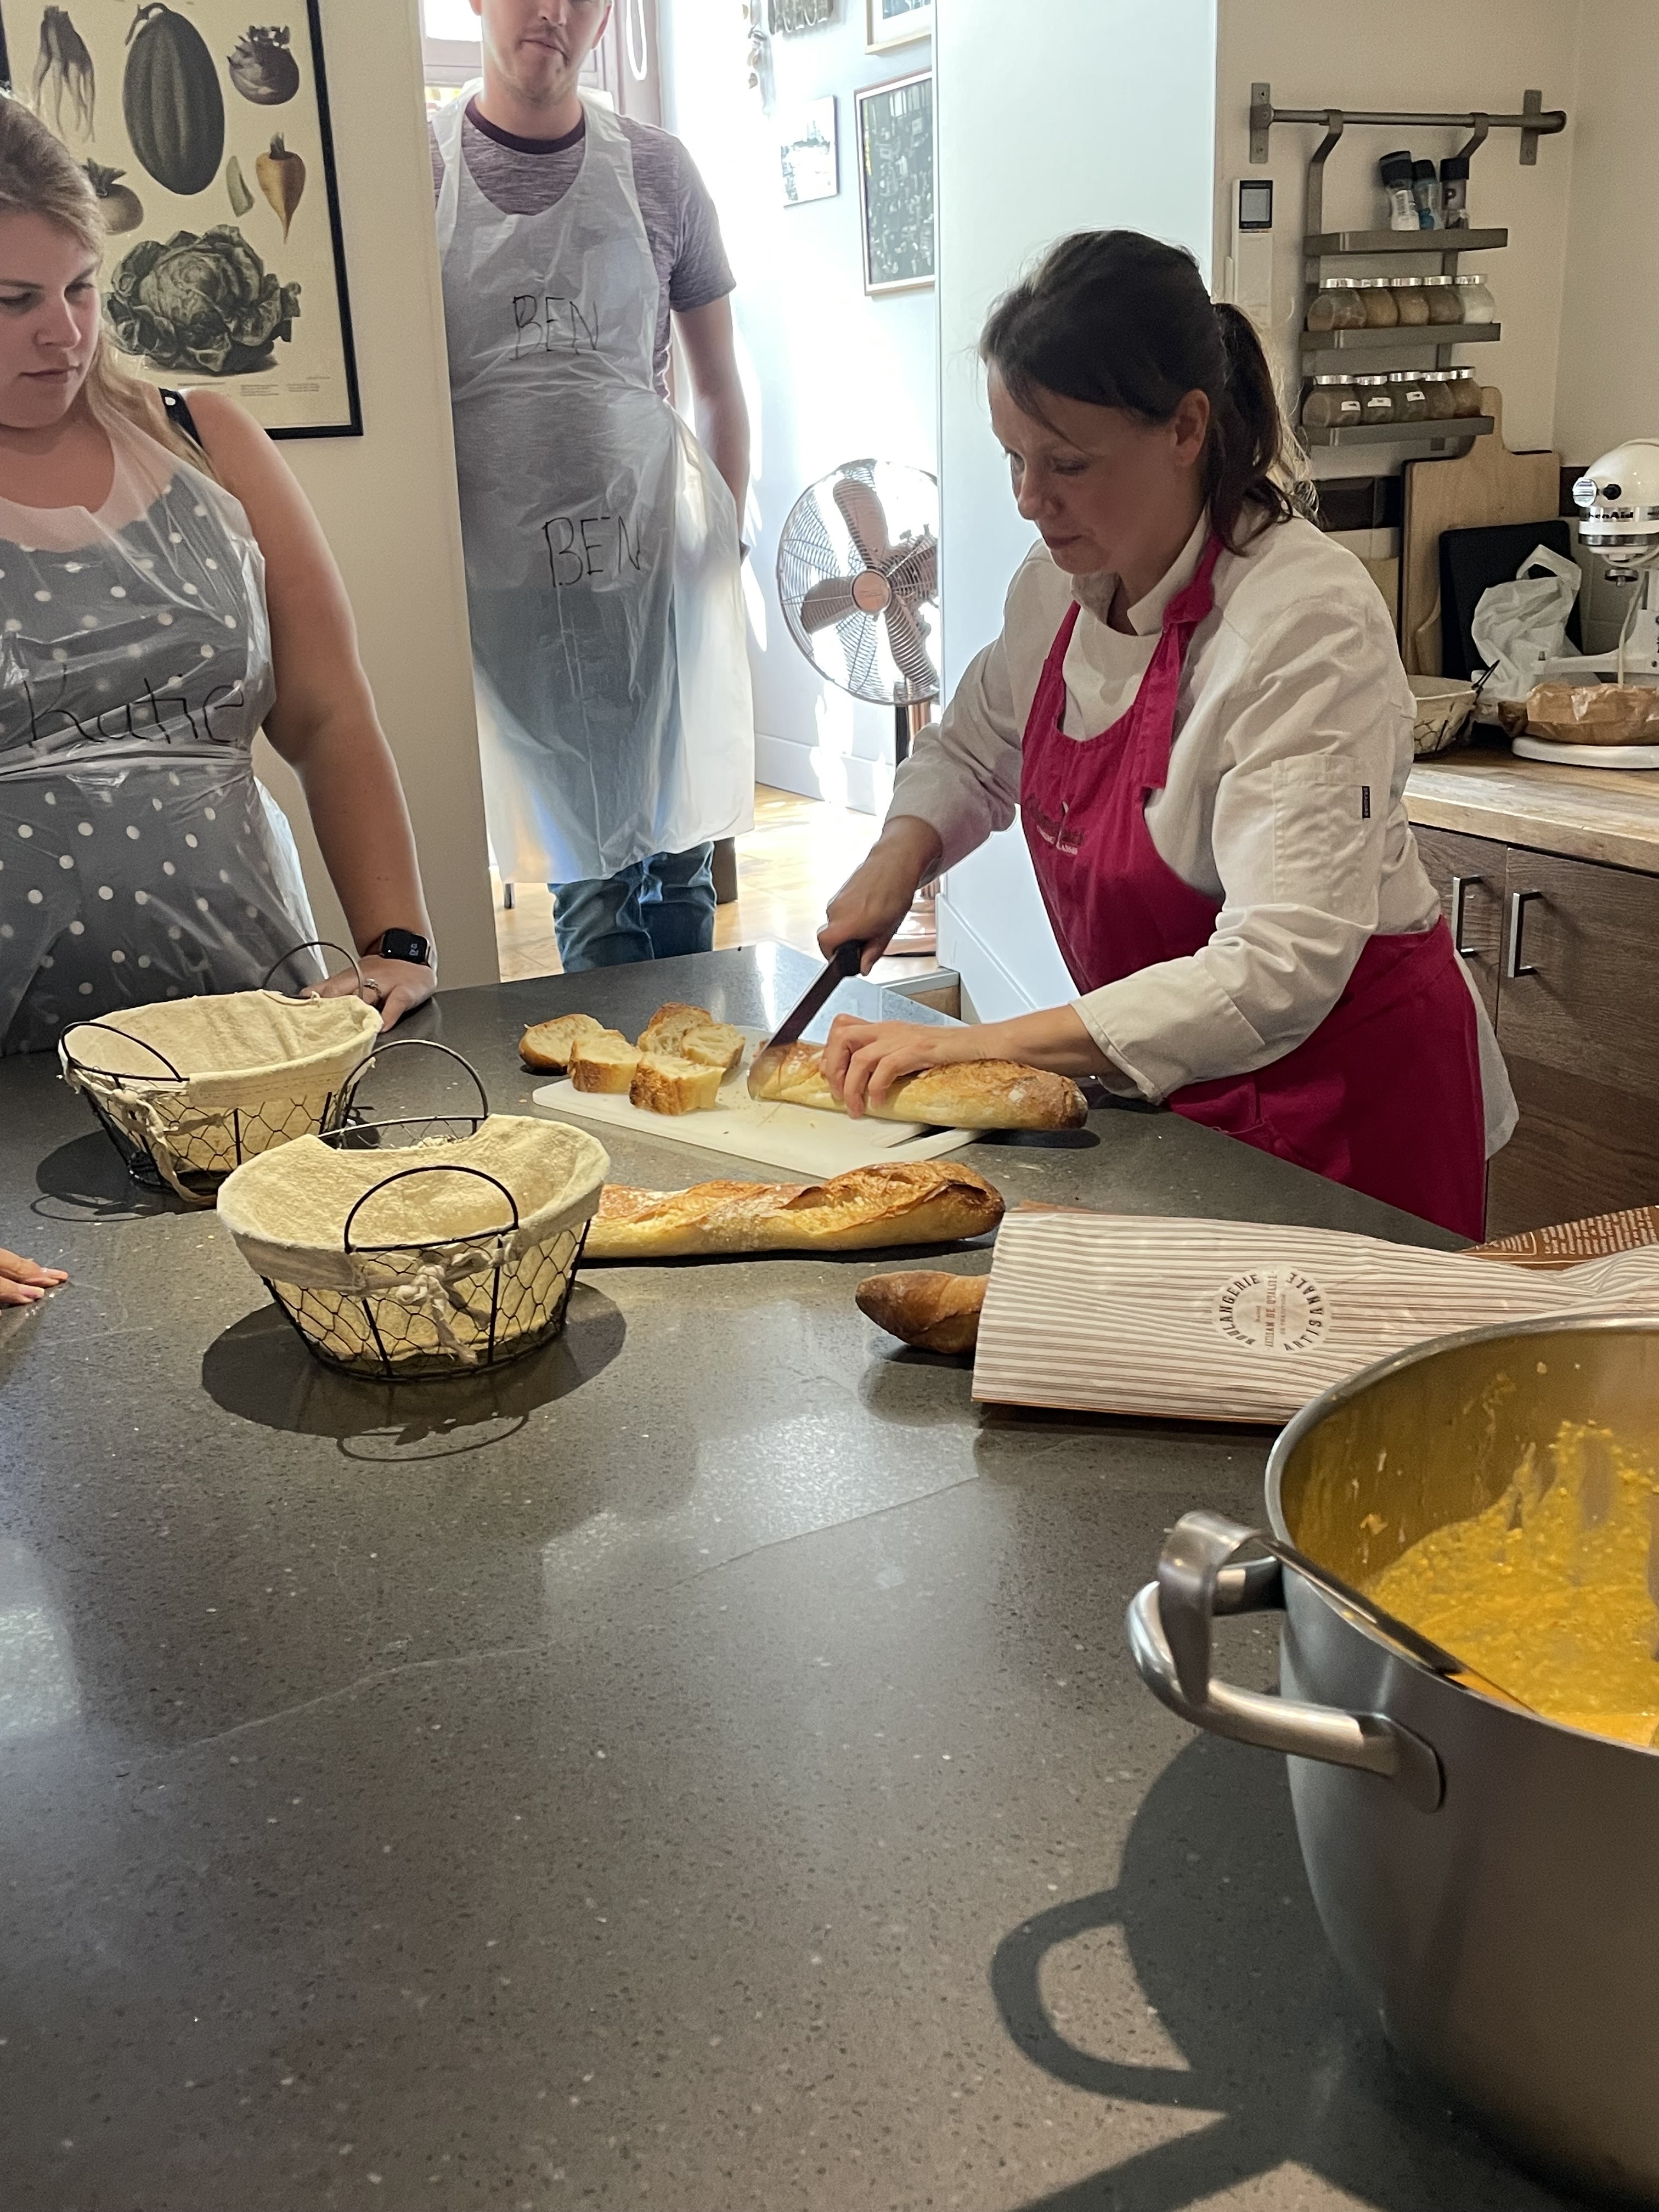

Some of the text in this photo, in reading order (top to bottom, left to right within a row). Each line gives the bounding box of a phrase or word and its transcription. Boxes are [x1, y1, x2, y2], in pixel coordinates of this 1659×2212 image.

[509, 295, 599, 360] BEN
[542, 515, 641, 588] BEN
[1219, 1274, 1261, 1345] BOULANGERIE
[1265, 1322, 1274, 1347] ARTISAN
[1266, 1308, 1276, 1318] DE
[1283, 1272, 1323, 1351] ARTISANALE
